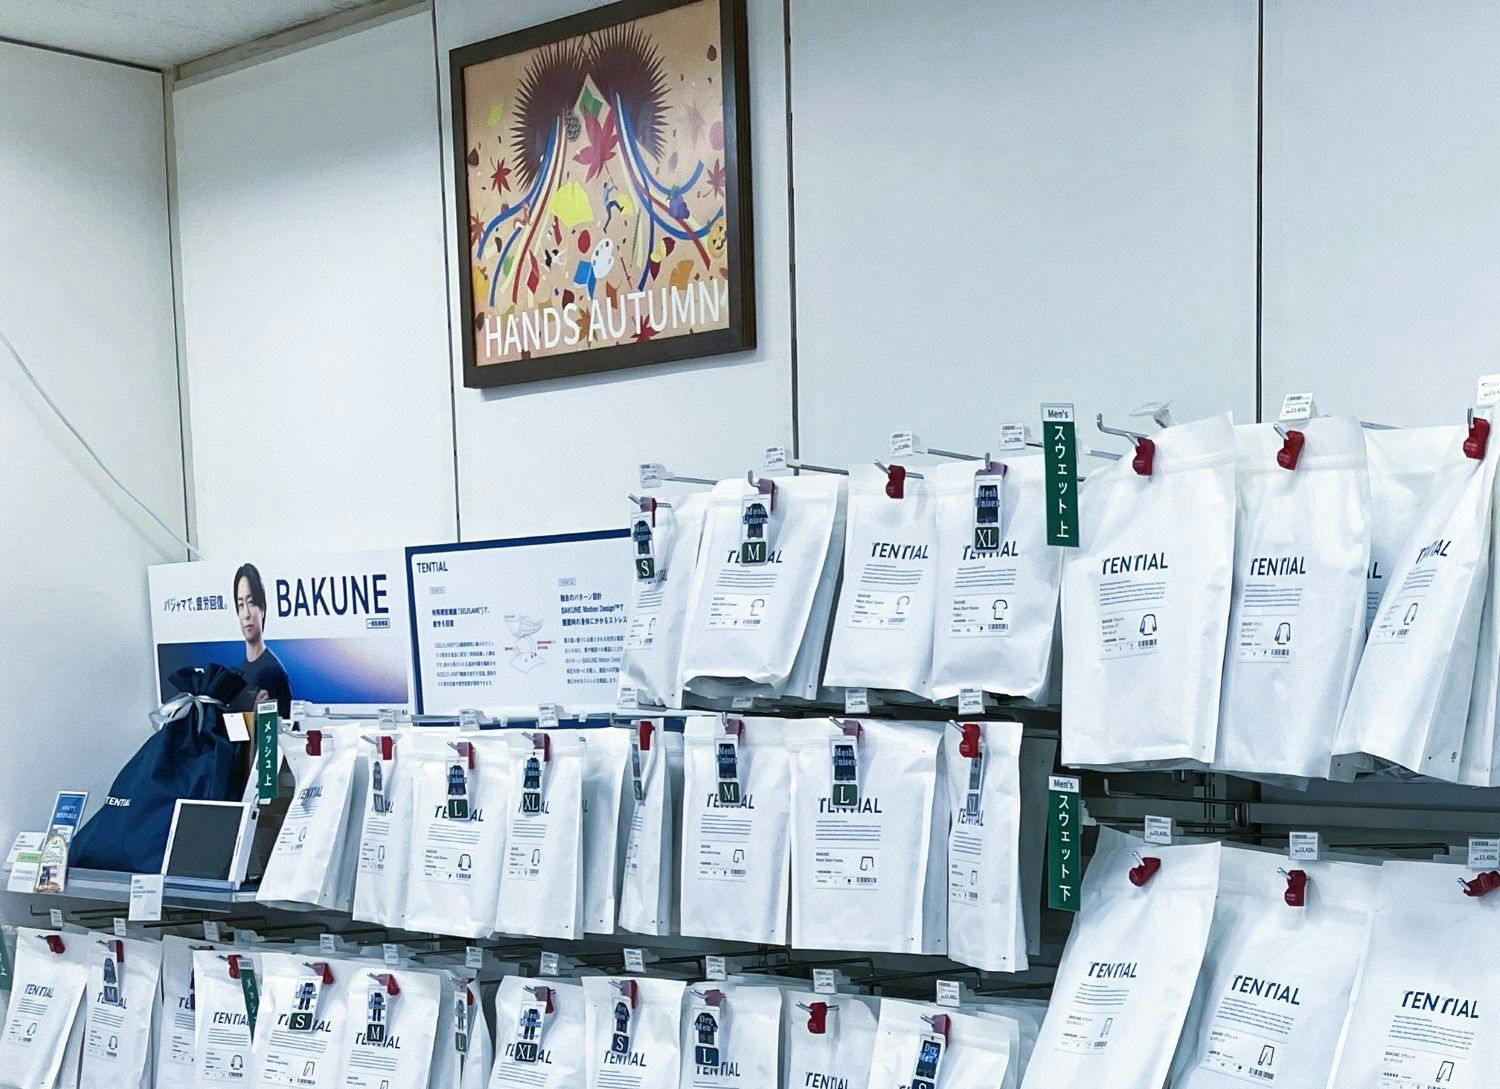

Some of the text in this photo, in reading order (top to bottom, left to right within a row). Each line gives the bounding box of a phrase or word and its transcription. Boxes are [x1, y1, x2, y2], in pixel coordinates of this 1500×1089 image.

[485, 279, 720, 358] HANDS AUTUMN
[1047, 409, 1069, 419] Men's
[1054, 424, 1070, 539] スウェット上
[976, 528, 997, 549] XL
[748, 546, 760, 562] M
[870, 541, 929, 560] TENTIAL
[417, 562, 448, 573] TENTIAL
[641, 560, 649, 576] S
[1101, 552, 1168, 576] TENTIAL
[1250, 556, 1306, 576] TENTIAL
[164, 595, 228, 612] パジャマで、疲労回復。
[276, 574, 389, 617] BAKUNE
[263, 720, 272, 787] メッシュ上
[722, 783, 735, 802] M
[1053, 779, 1074, 789] Men's
[522, 793, 540, 813] XL
[839, 784, 849, 804] L
[453, 800, 464, 819] L
[1058, 794, 1072, 902] スウェット下
[1087, 961, 1138, 979] TENTIAL
[24, 983, 55, 999] TENTIAL
[1231, 974, 1301, 1006] TENTIAL
[1401, 990, 1479, 1019] TENTIAL
[295, 1014, 305, 1028] S
[369, 1025, 382, 1040] M
[517, 1043, 537, 1060] XL
[616, 1036, 626, 1050] S
[702, 1048, 712, 1064] L
